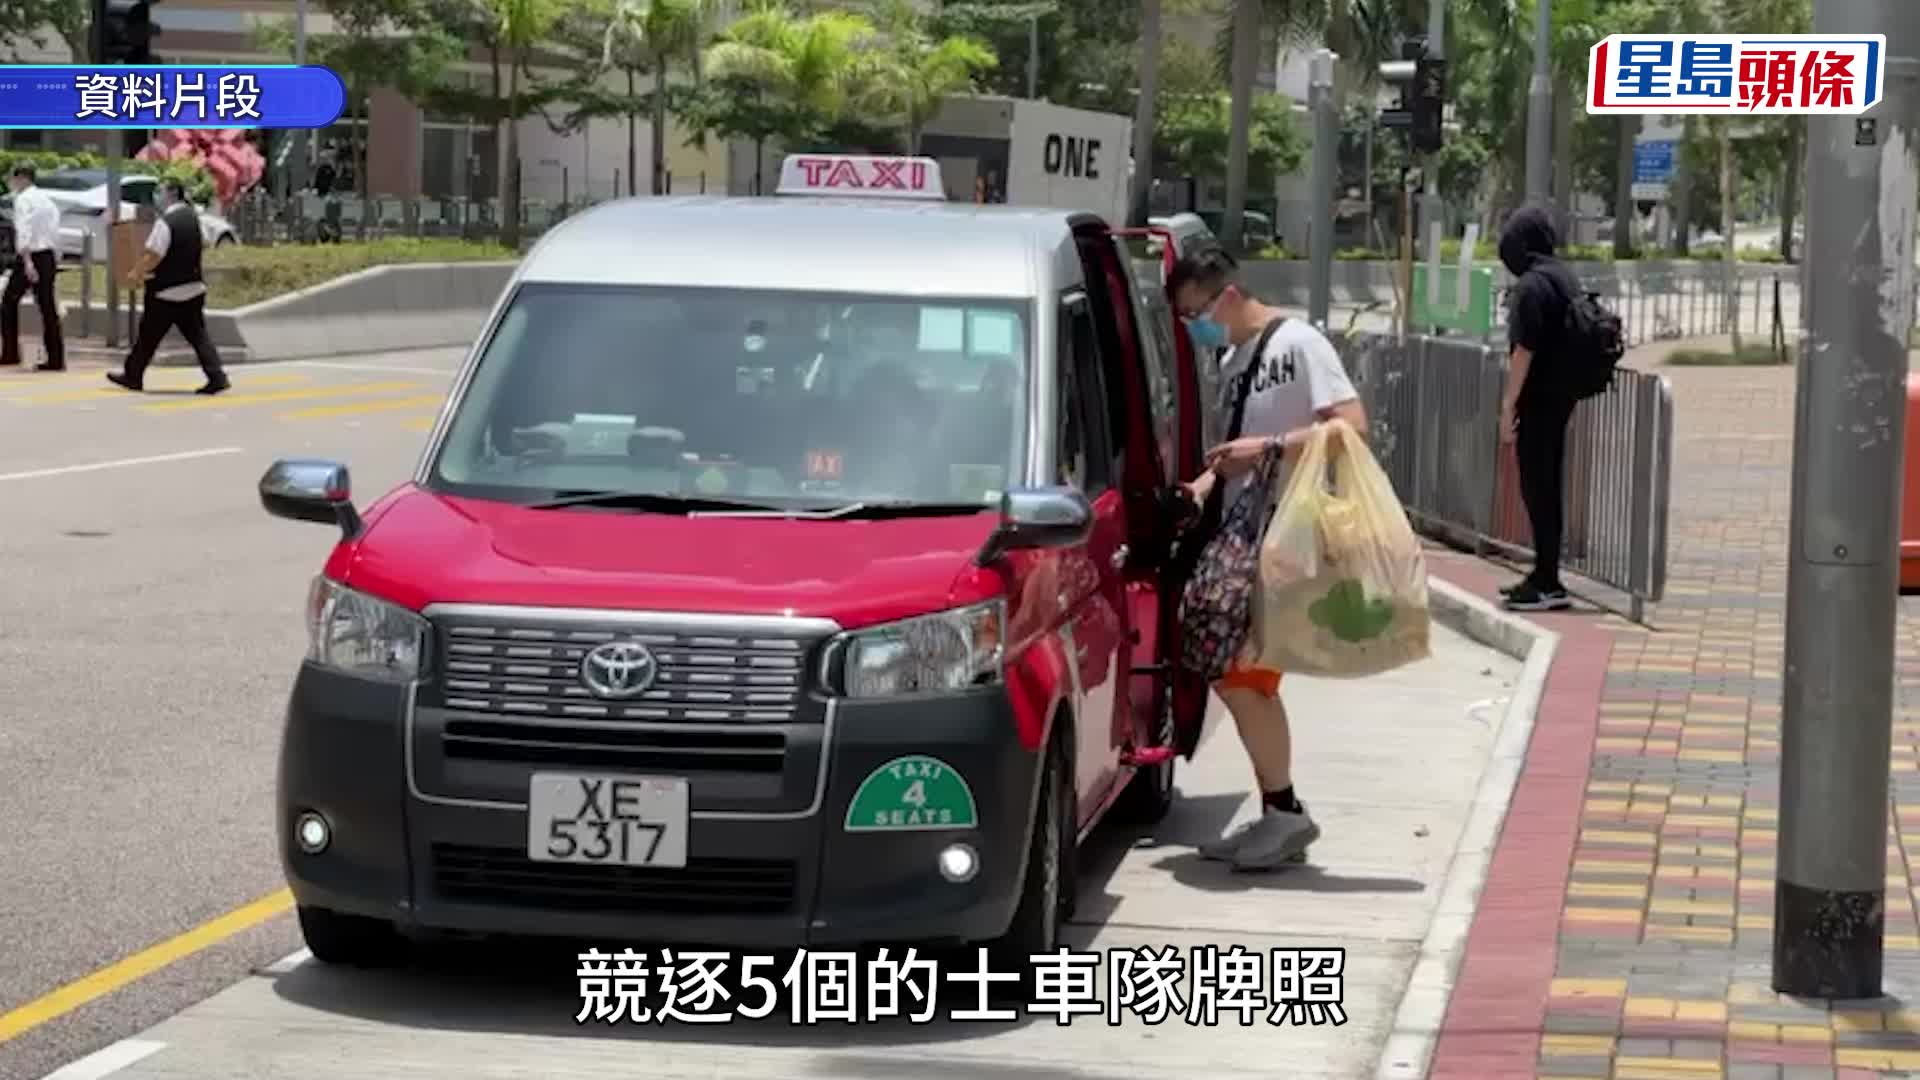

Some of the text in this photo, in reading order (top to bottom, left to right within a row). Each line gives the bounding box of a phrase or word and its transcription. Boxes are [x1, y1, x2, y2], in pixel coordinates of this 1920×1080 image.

[1044, 133, 1101, 179] ONE
[797, 158, 926, 190] TAXI
[889, 762, 942, 780] TAXI
[577, 778, 641, 820] XE
[902, 779, 926, 807] 4
[874, 808, 953, 825] SEATS
[547, 820, 667, 862] 5317
